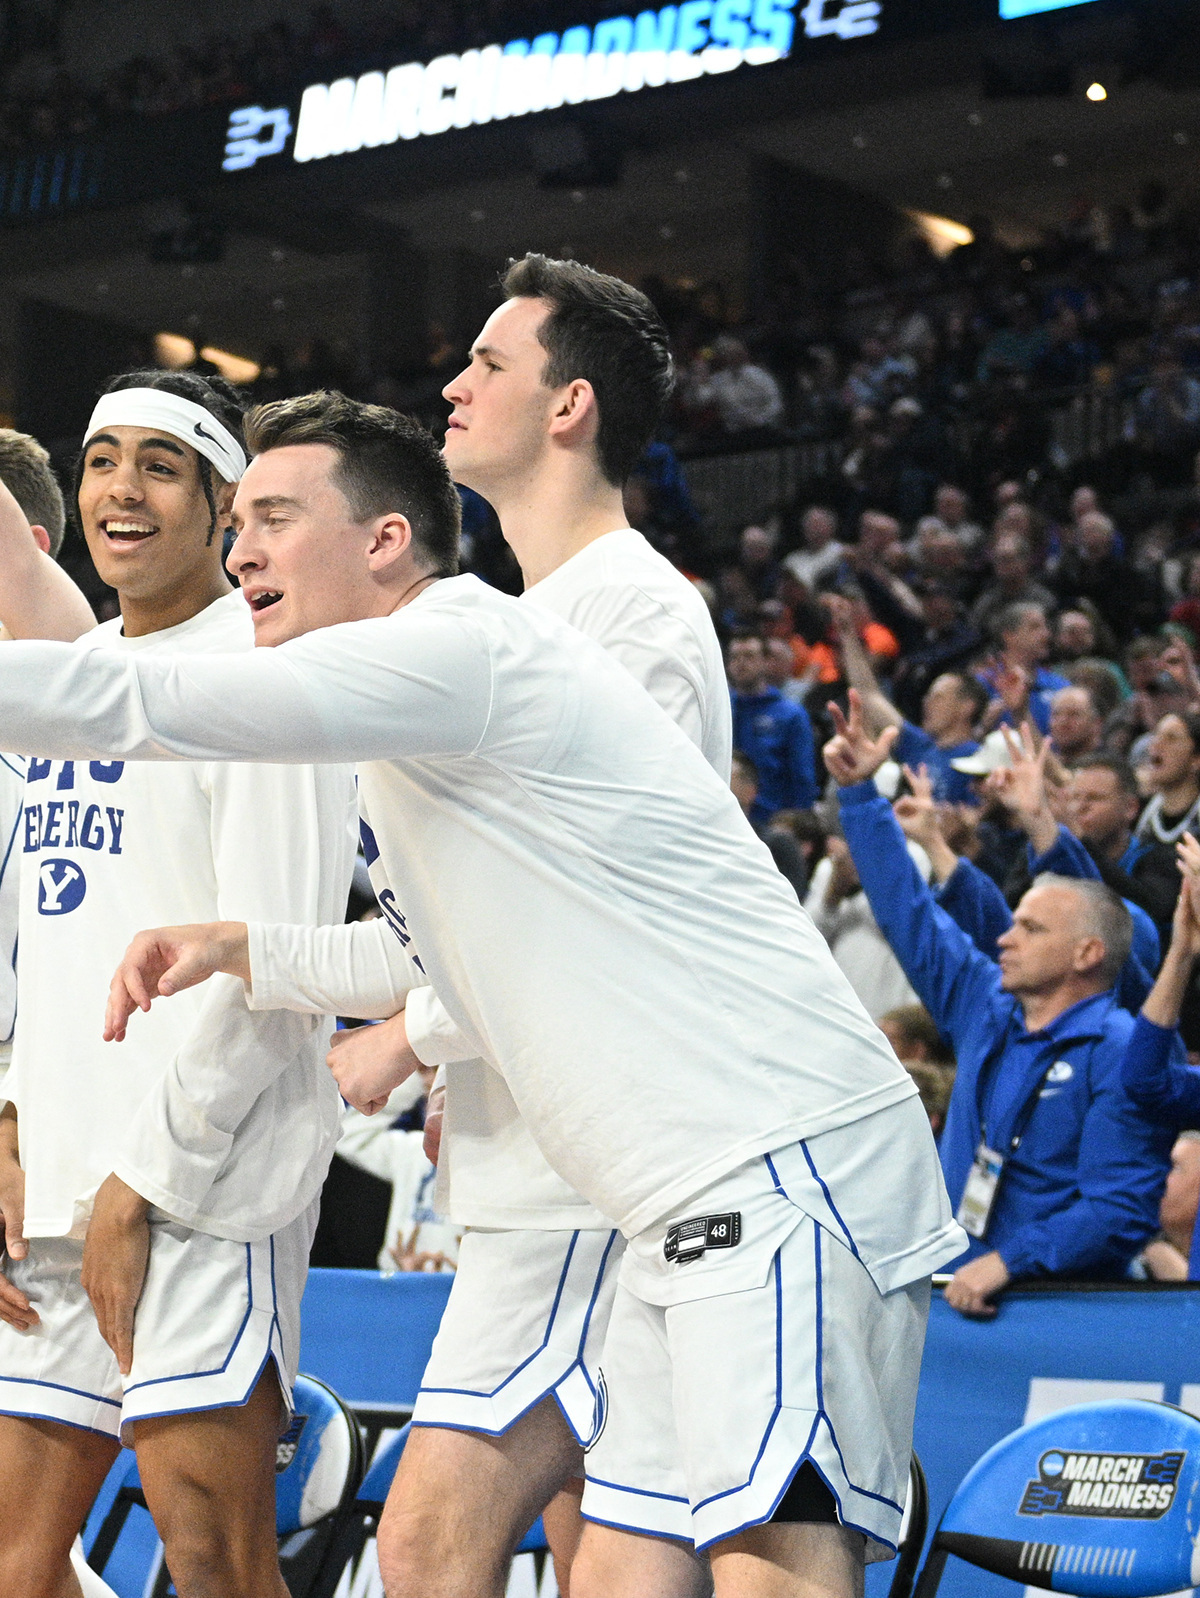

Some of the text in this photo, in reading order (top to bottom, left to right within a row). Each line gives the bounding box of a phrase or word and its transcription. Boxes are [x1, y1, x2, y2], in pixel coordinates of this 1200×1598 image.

[710, 1223, 727, 1238] 48
[1061, 1454, 1144, 1483] MARCH
[1065, 1480, 1175, 1510] MADNESS
